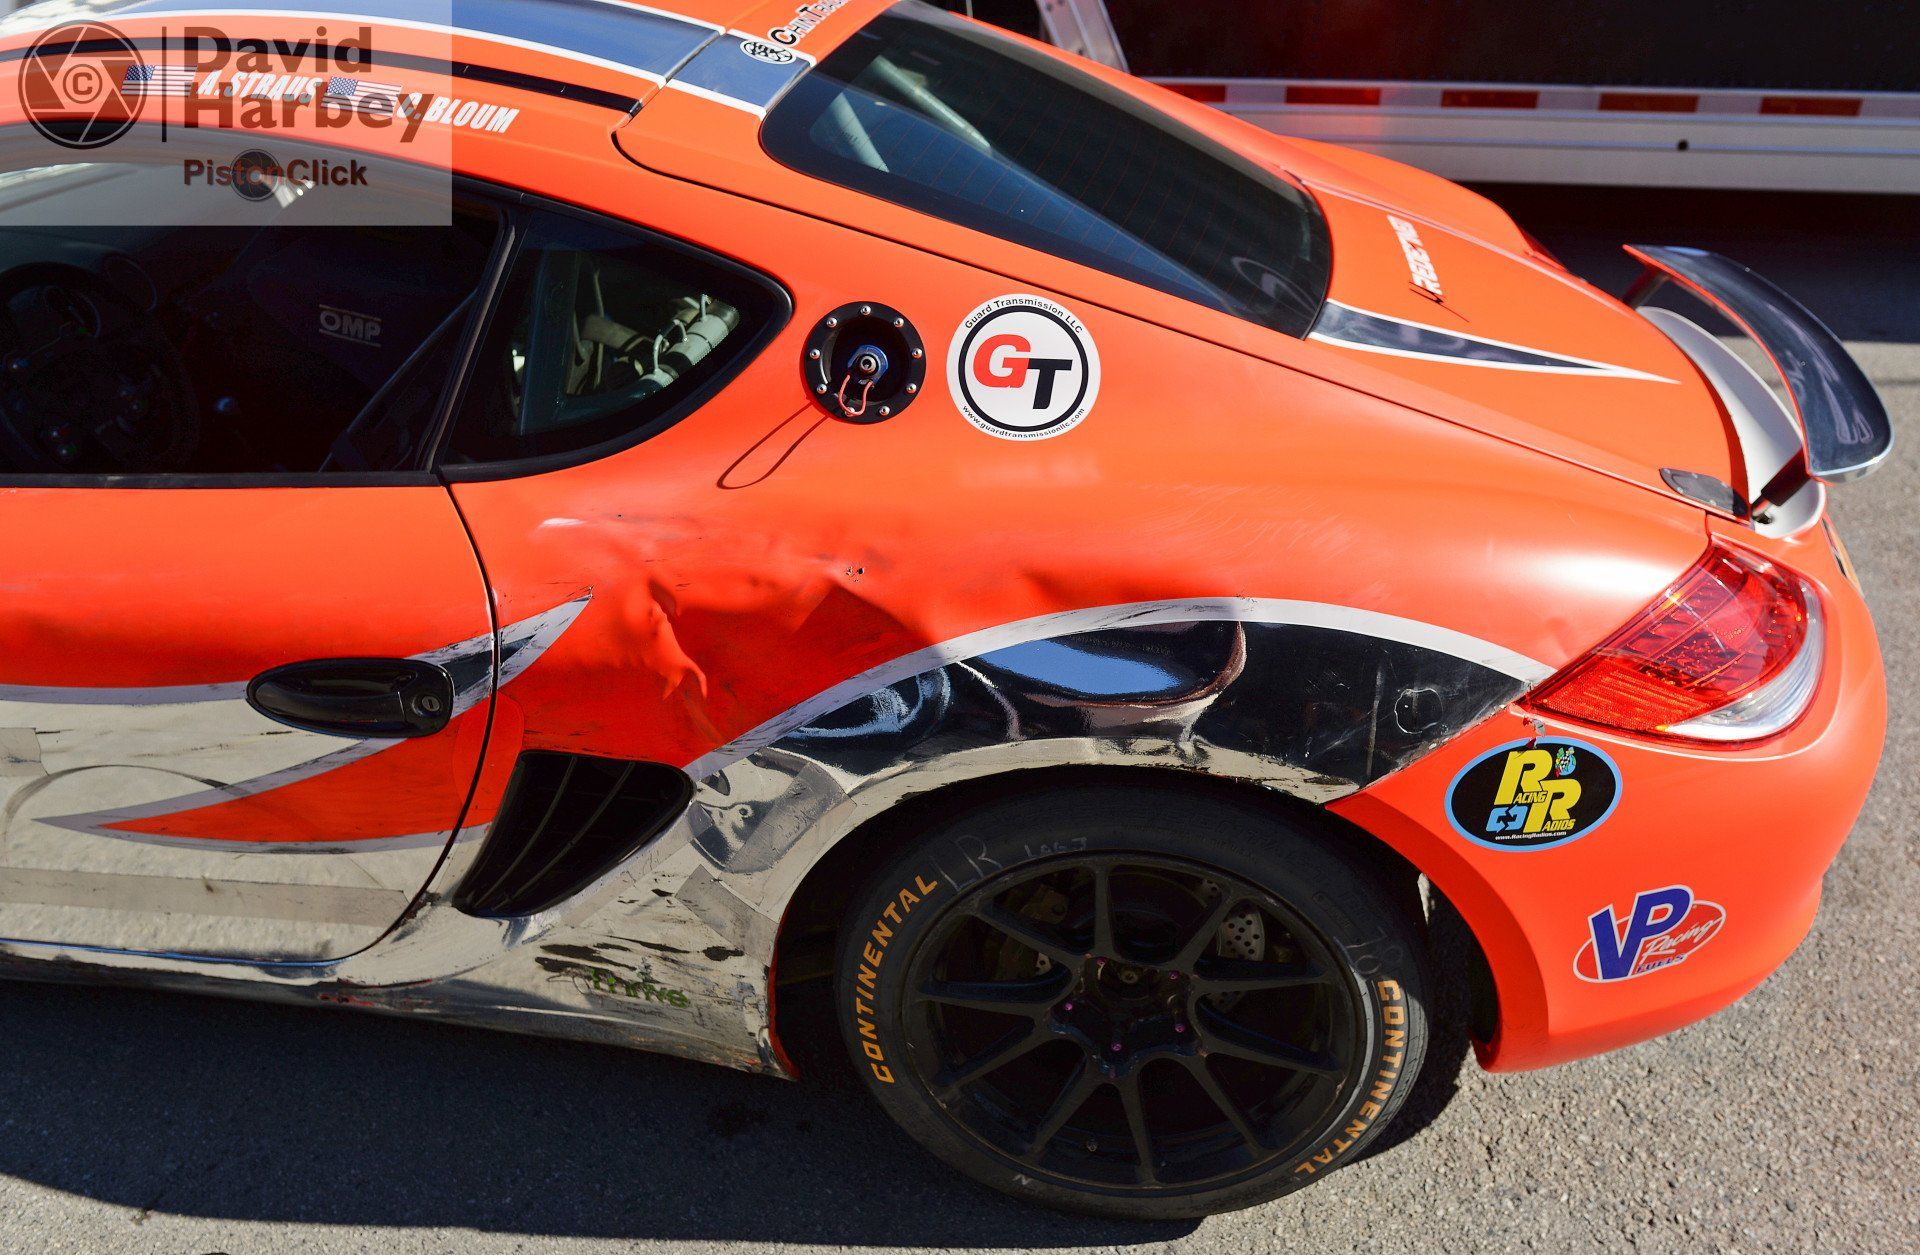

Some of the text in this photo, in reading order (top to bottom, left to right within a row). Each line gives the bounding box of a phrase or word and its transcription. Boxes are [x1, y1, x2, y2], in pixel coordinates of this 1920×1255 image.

[320, 310, 381, 340] OMP
[965, 298, 1083, 334] Guard Transmission LLC
[973, 333, 1073, 409] GT
[962, 405, 1085, 438] www.guardtransmissionllc.com
[1588, 884, 1694, 981] VP
[855, 875, 938, 1084] CONTINENTAL
[1295, 978, 1405, 1174] CONTINENTAL
